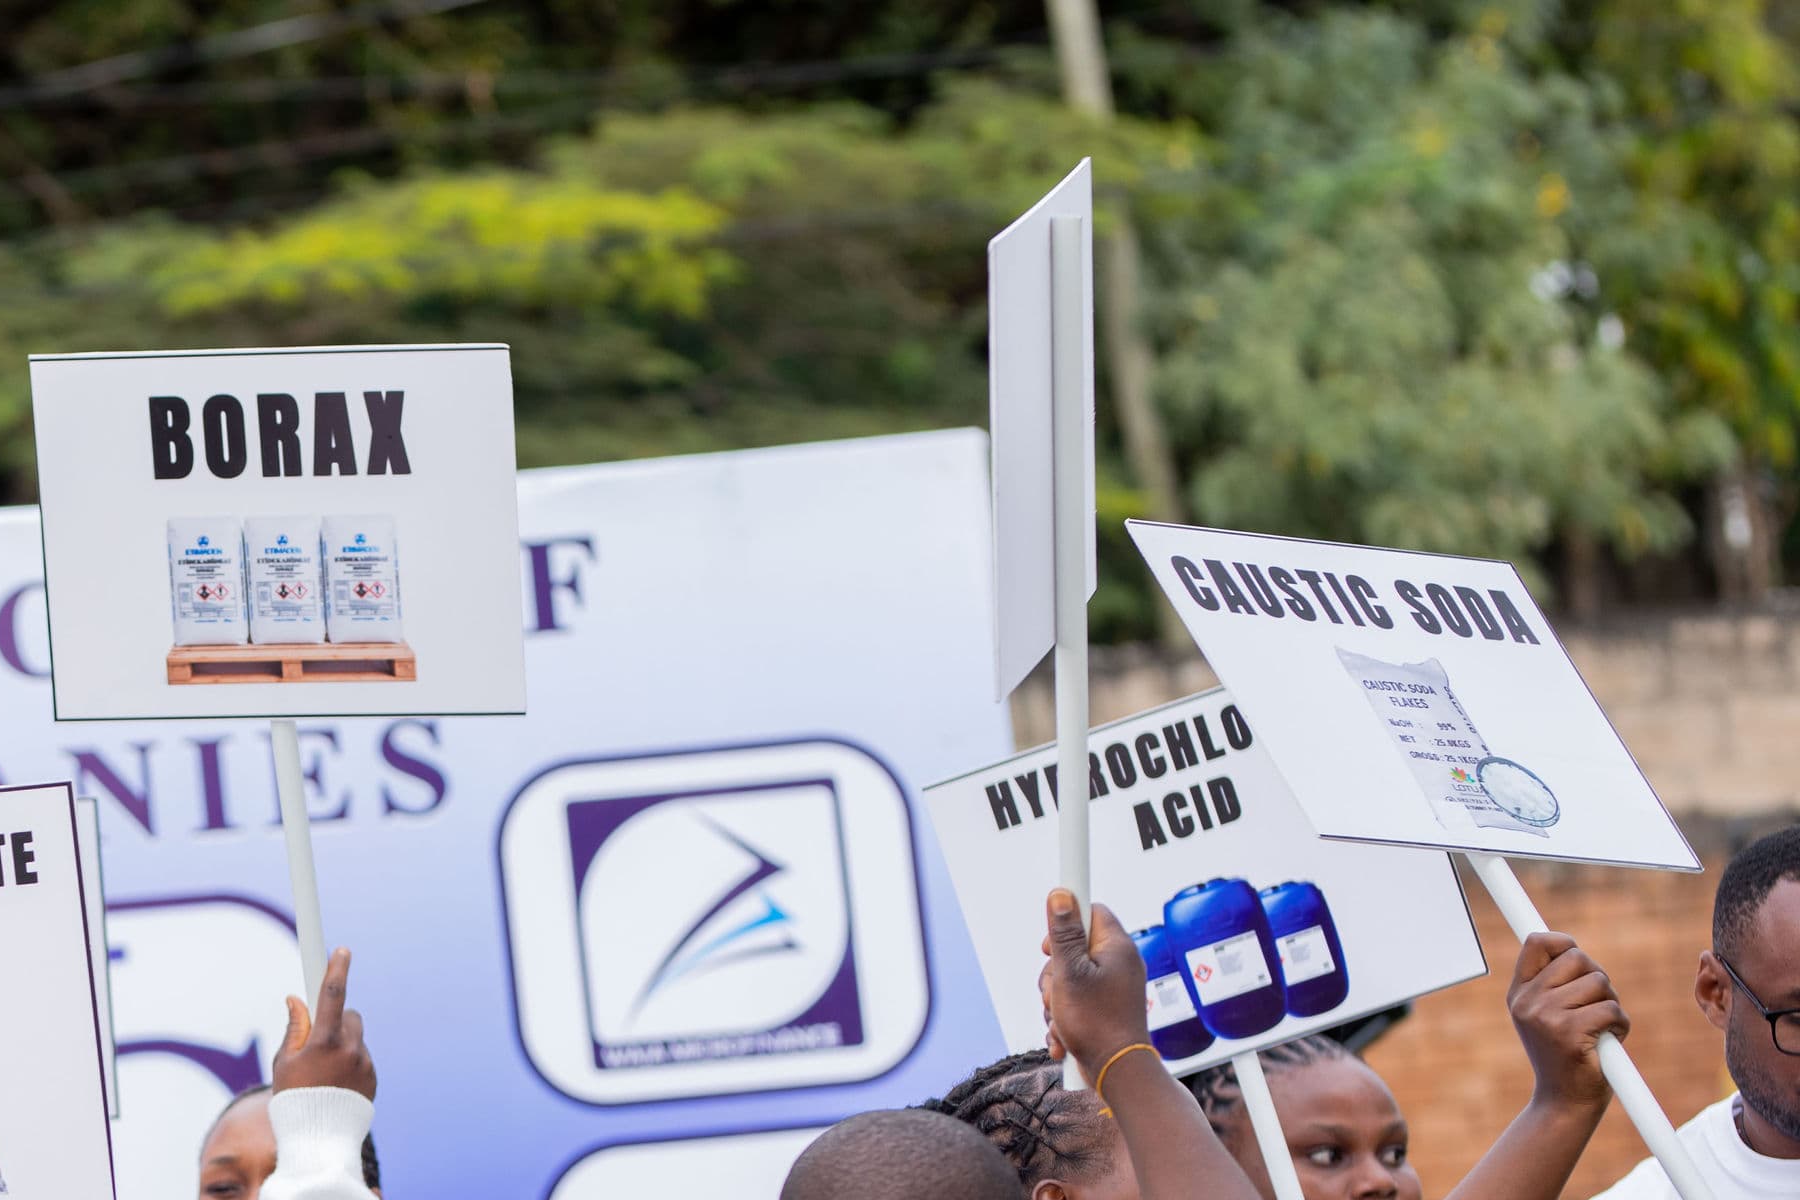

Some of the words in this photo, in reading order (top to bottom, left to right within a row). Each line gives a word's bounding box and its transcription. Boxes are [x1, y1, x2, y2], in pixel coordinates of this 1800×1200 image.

[149, 391, 412, 480] BORAX
[1171, 555, 1394, 630] CAUSTIC
[1394, 579, 1541, 645] SODA
[1362, 680, 1407, 692] CAUSTIC
[1407, 684, 1437, 696] SODA
[1389, 696, 1429, 708] FLAKES
[1133, 776, 1242, 851] ACID
